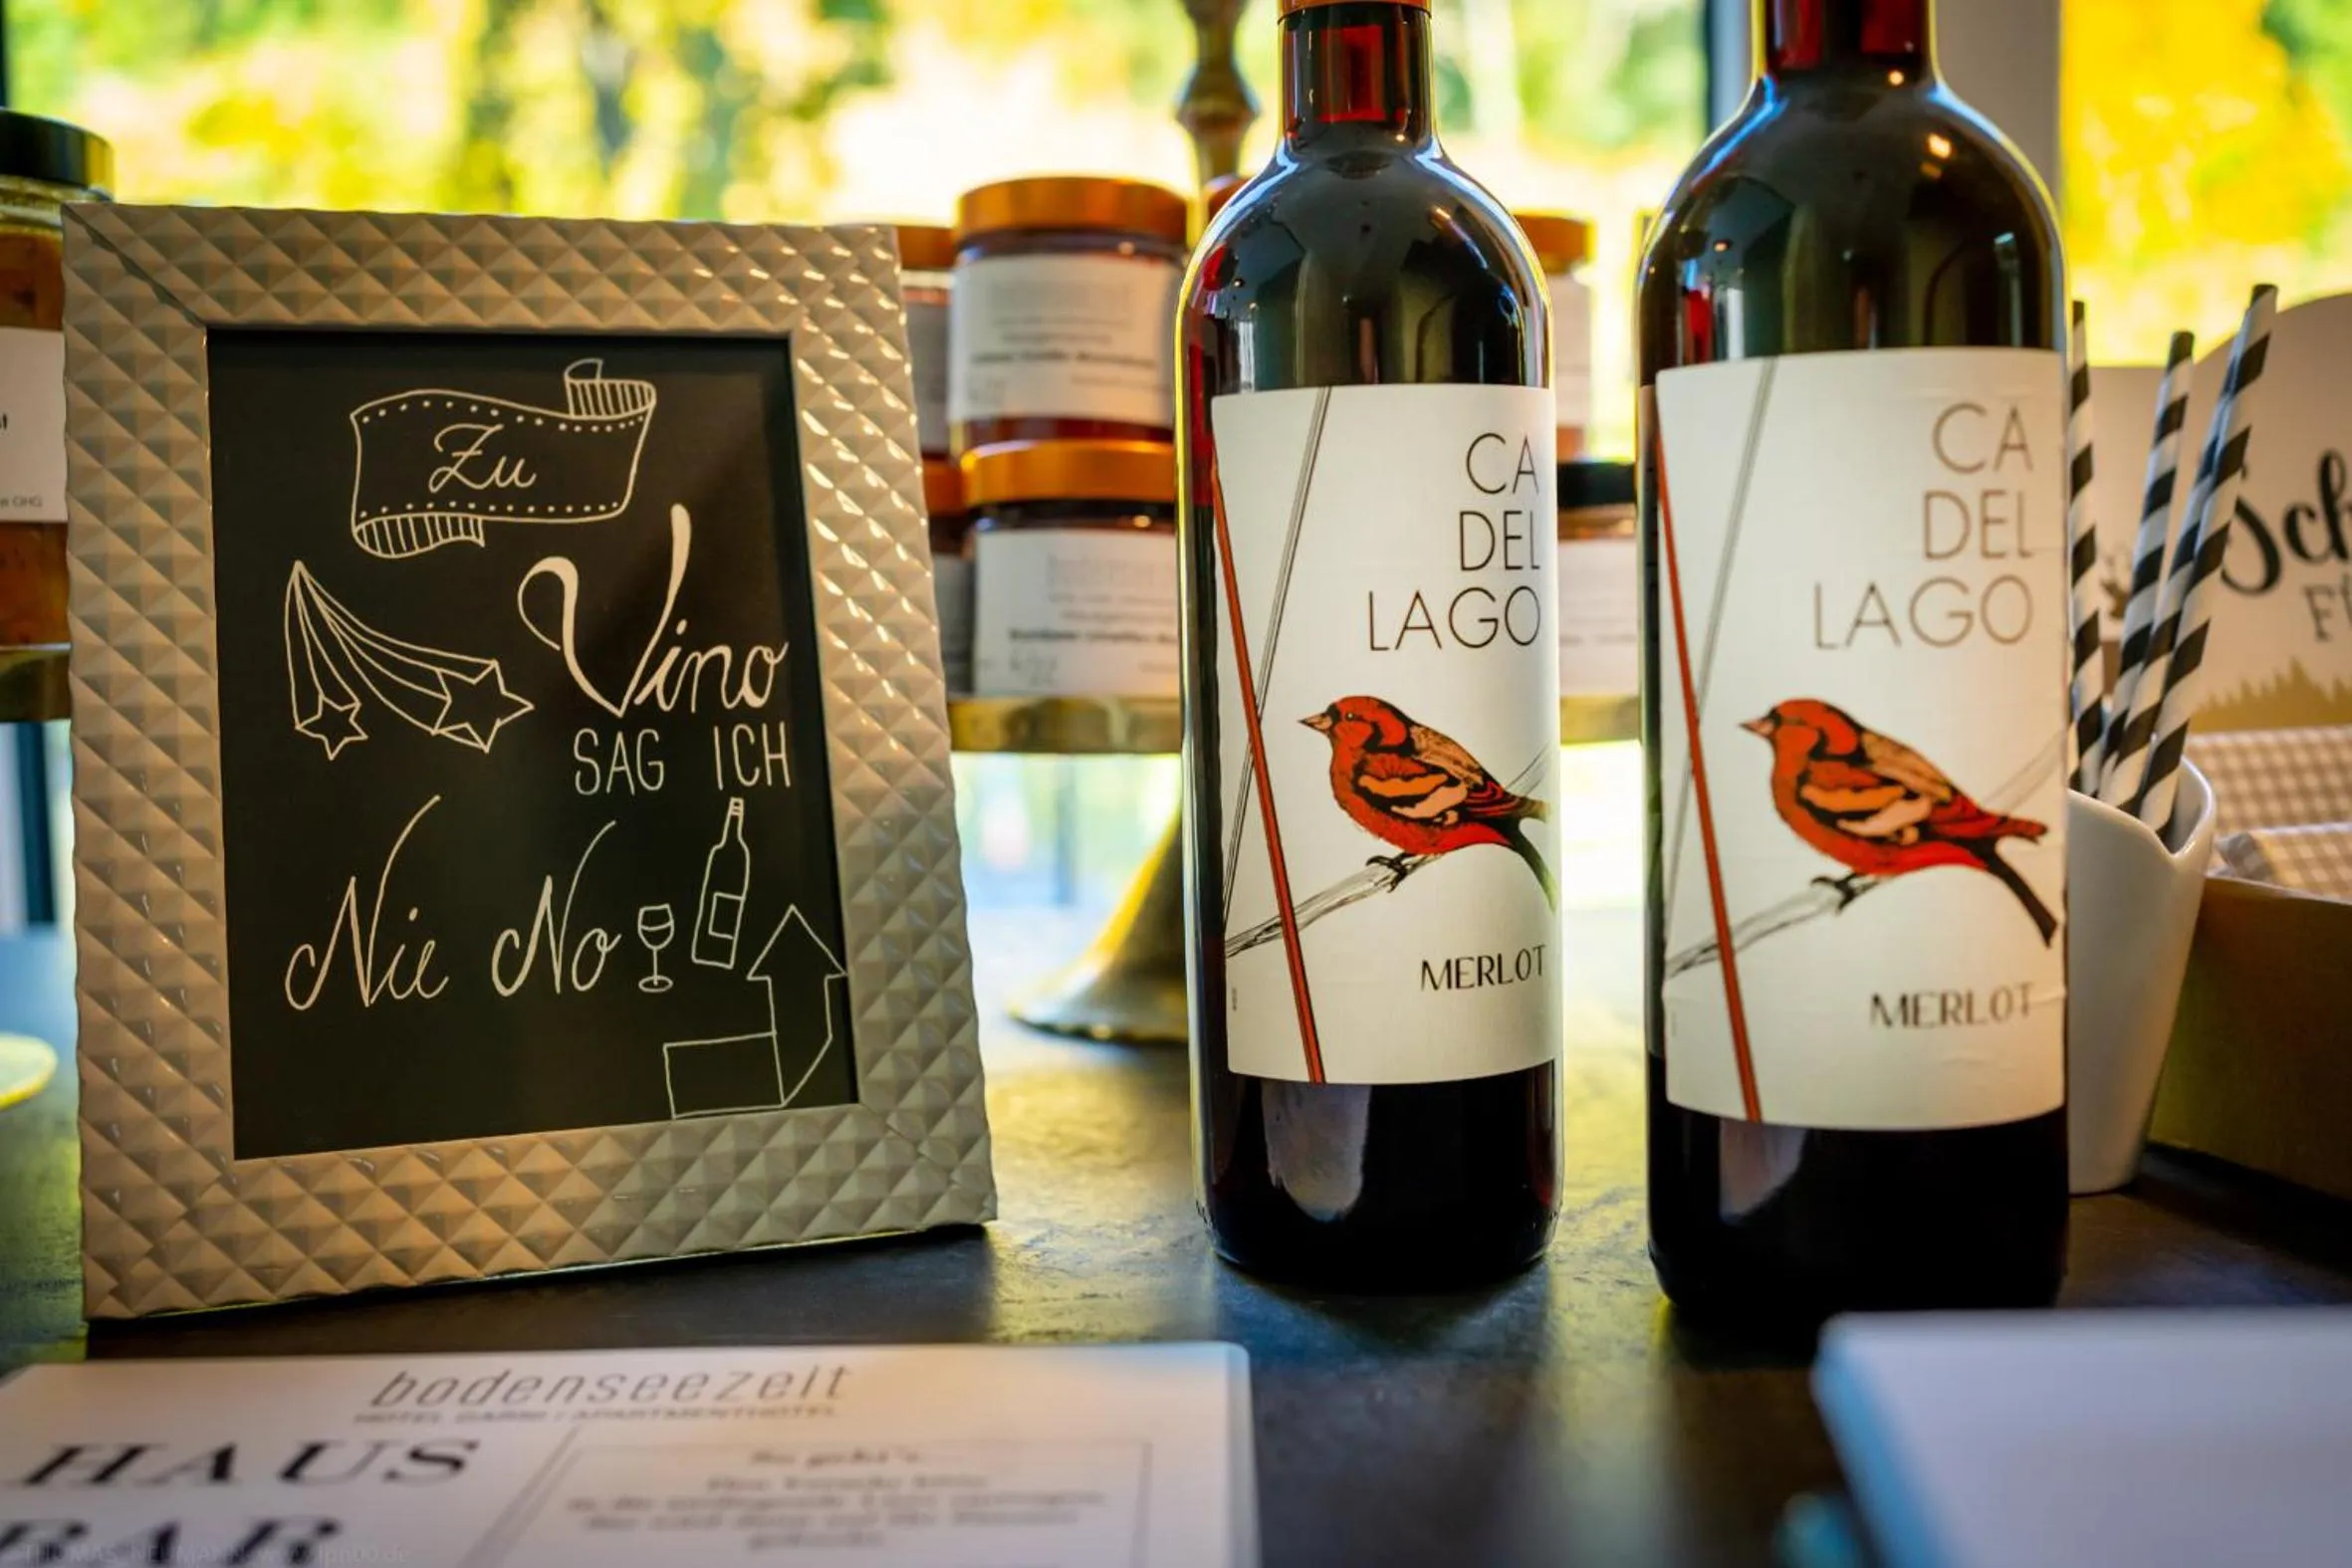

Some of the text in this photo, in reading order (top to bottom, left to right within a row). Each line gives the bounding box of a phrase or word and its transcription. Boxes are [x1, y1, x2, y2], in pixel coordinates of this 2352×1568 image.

[428, 424, 536, 493] Zu
[1466, 432, 1539, 495] CA
[1933, 402, 2033, 473] CA
[1459, 510, 1540, 571] DEL
[1924, 490, 2033, 560] DEL
[518, 504, 789, 717] Vino
[1369, 585, 1540, 651] LAGO
[1814, 573, 2034, 649] LAGO
[574, 722, 791, 795] SAG ICH
[285, 795, 621, 1010] Nie No
[1420, 943, 1546, 993] MERLOT
[1869, 982, 2034, 1030] MERLOT
[369, 1363, 850, 1408] bodenseezeit
[18, 1439, 480, 1487] HAUS
